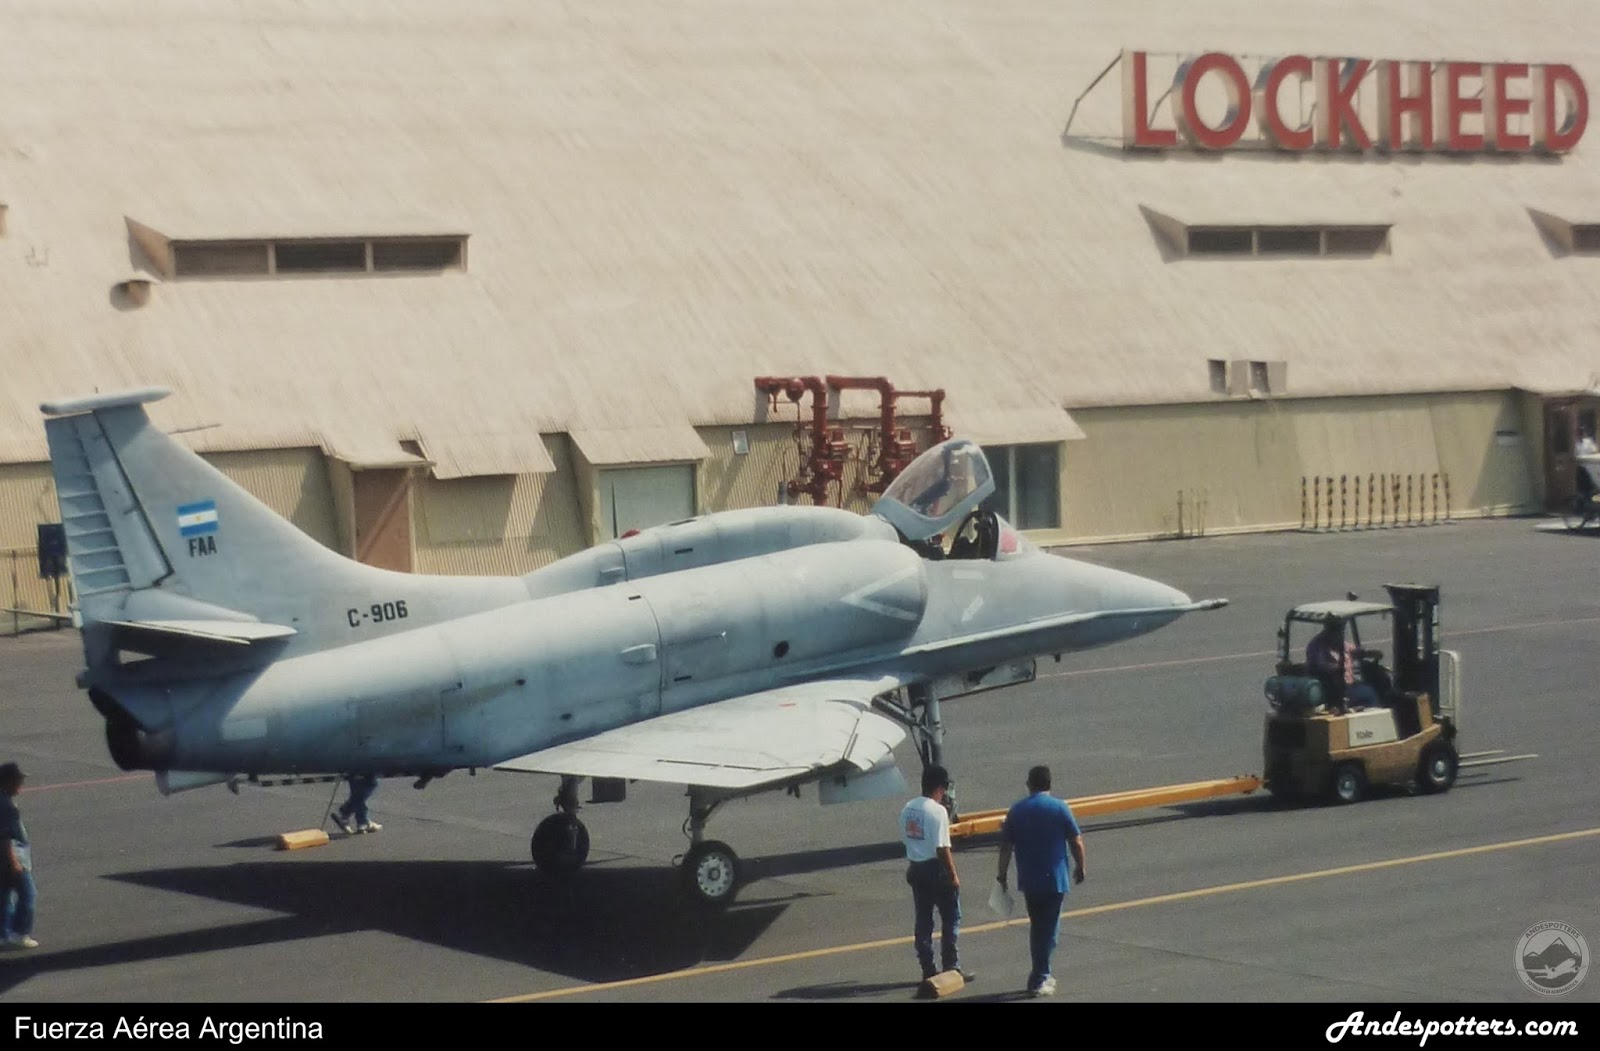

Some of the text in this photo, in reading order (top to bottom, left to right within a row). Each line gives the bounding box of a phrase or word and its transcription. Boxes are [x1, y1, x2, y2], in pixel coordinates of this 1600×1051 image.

[1126, 51, 1589, 151] LOCKHEED
[188, 535, 218, 558] FAA
[346, 599, 409, 628] C-906
